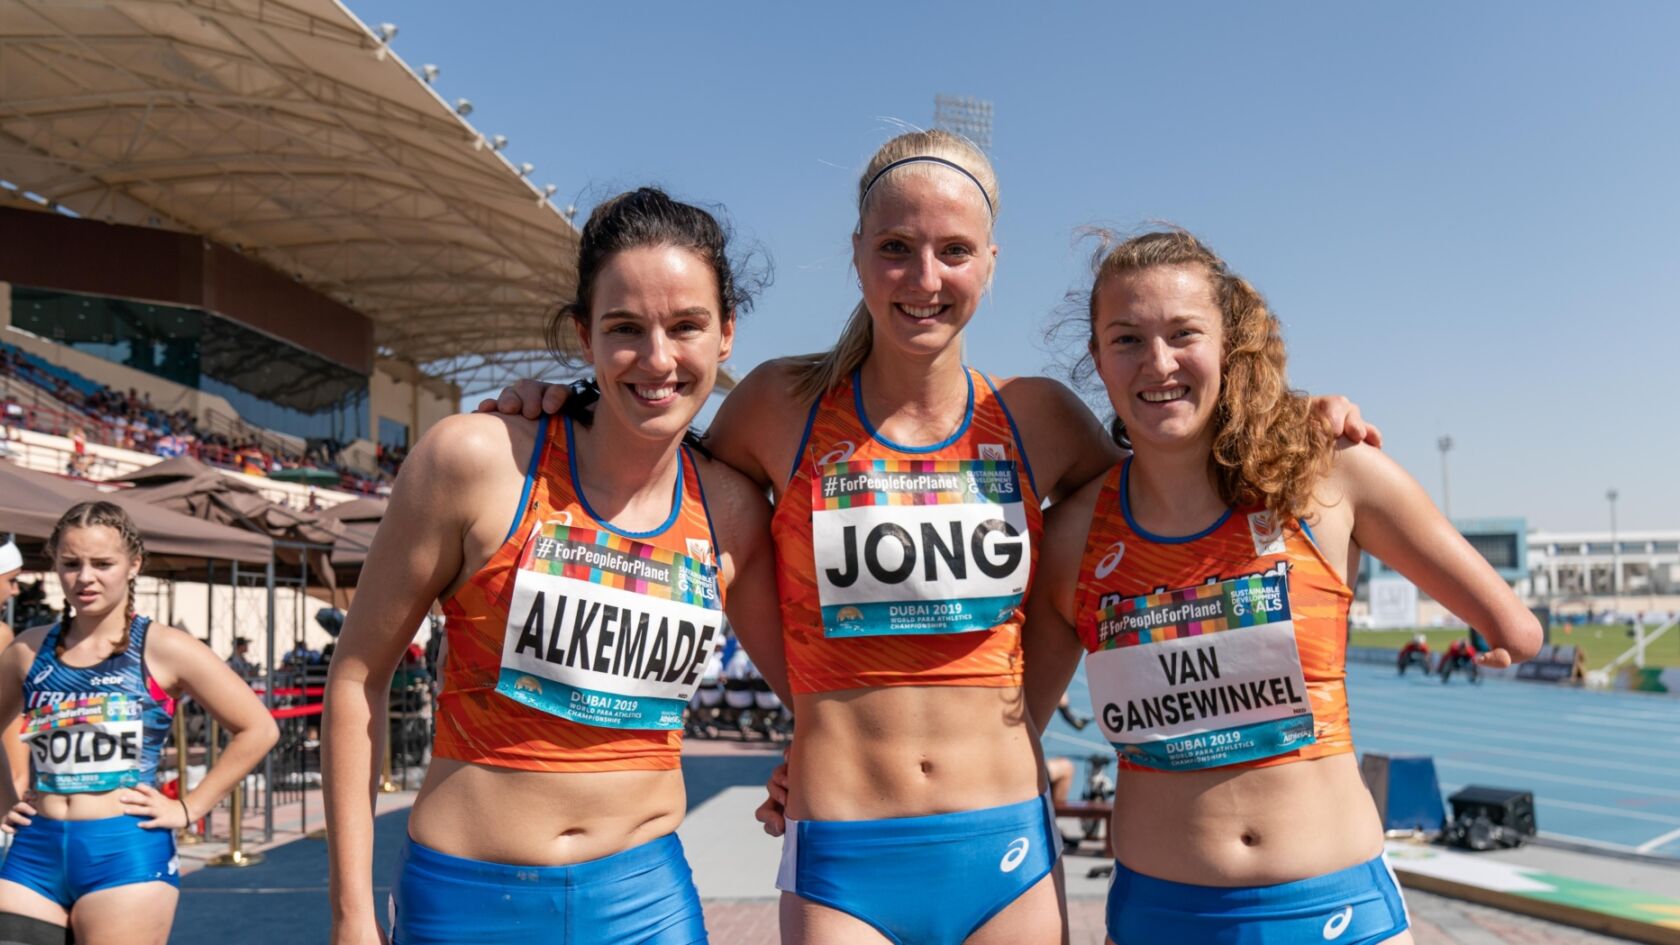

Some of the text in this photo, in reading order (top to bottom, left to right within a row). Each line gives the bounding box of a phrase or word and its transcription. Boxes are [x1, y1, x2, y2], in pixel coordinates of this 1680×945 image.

[966, 470, 1011, 478] SUSTAINABLE
[824, 475, 958, 497] #ForPeopleForPlanet
[537, 537, 670, 583] #ForPeopleForPlanet
[825, 518, 1023, 588] JONG
[1231, 585, 1280, 600] SUSTAINABLE
[1231, 592, 1280, 605] DEVELOPMENT
[889, 603, 962, 617] DUBAI 2019
[938, 613, 973, 622] ATHLETICS
[1099, 600, 1222, 641] #ForPeopleForPlanet
[890, 622, 948, 630] CHAMPIONSHIPS
[514, 590, 715, 686] ALKEMADE
[1158, 646, 1220, 686] VAN
[569, 702, 642, 719] WORLD PARA ATHLETICS
[571, 691, 639, 711] DUBAI 2019
[1102, 676, 1303, 734] GANSEWINKEL
[567, 709, 622, 725] CHAMPIONSHIPS
[31, 730, 136, 764] SOLDE
[1166, 731, 1241, 753] DUBAI 2019
[1169, 740, 1255, 761] WORLD PARA ATHLETICS
